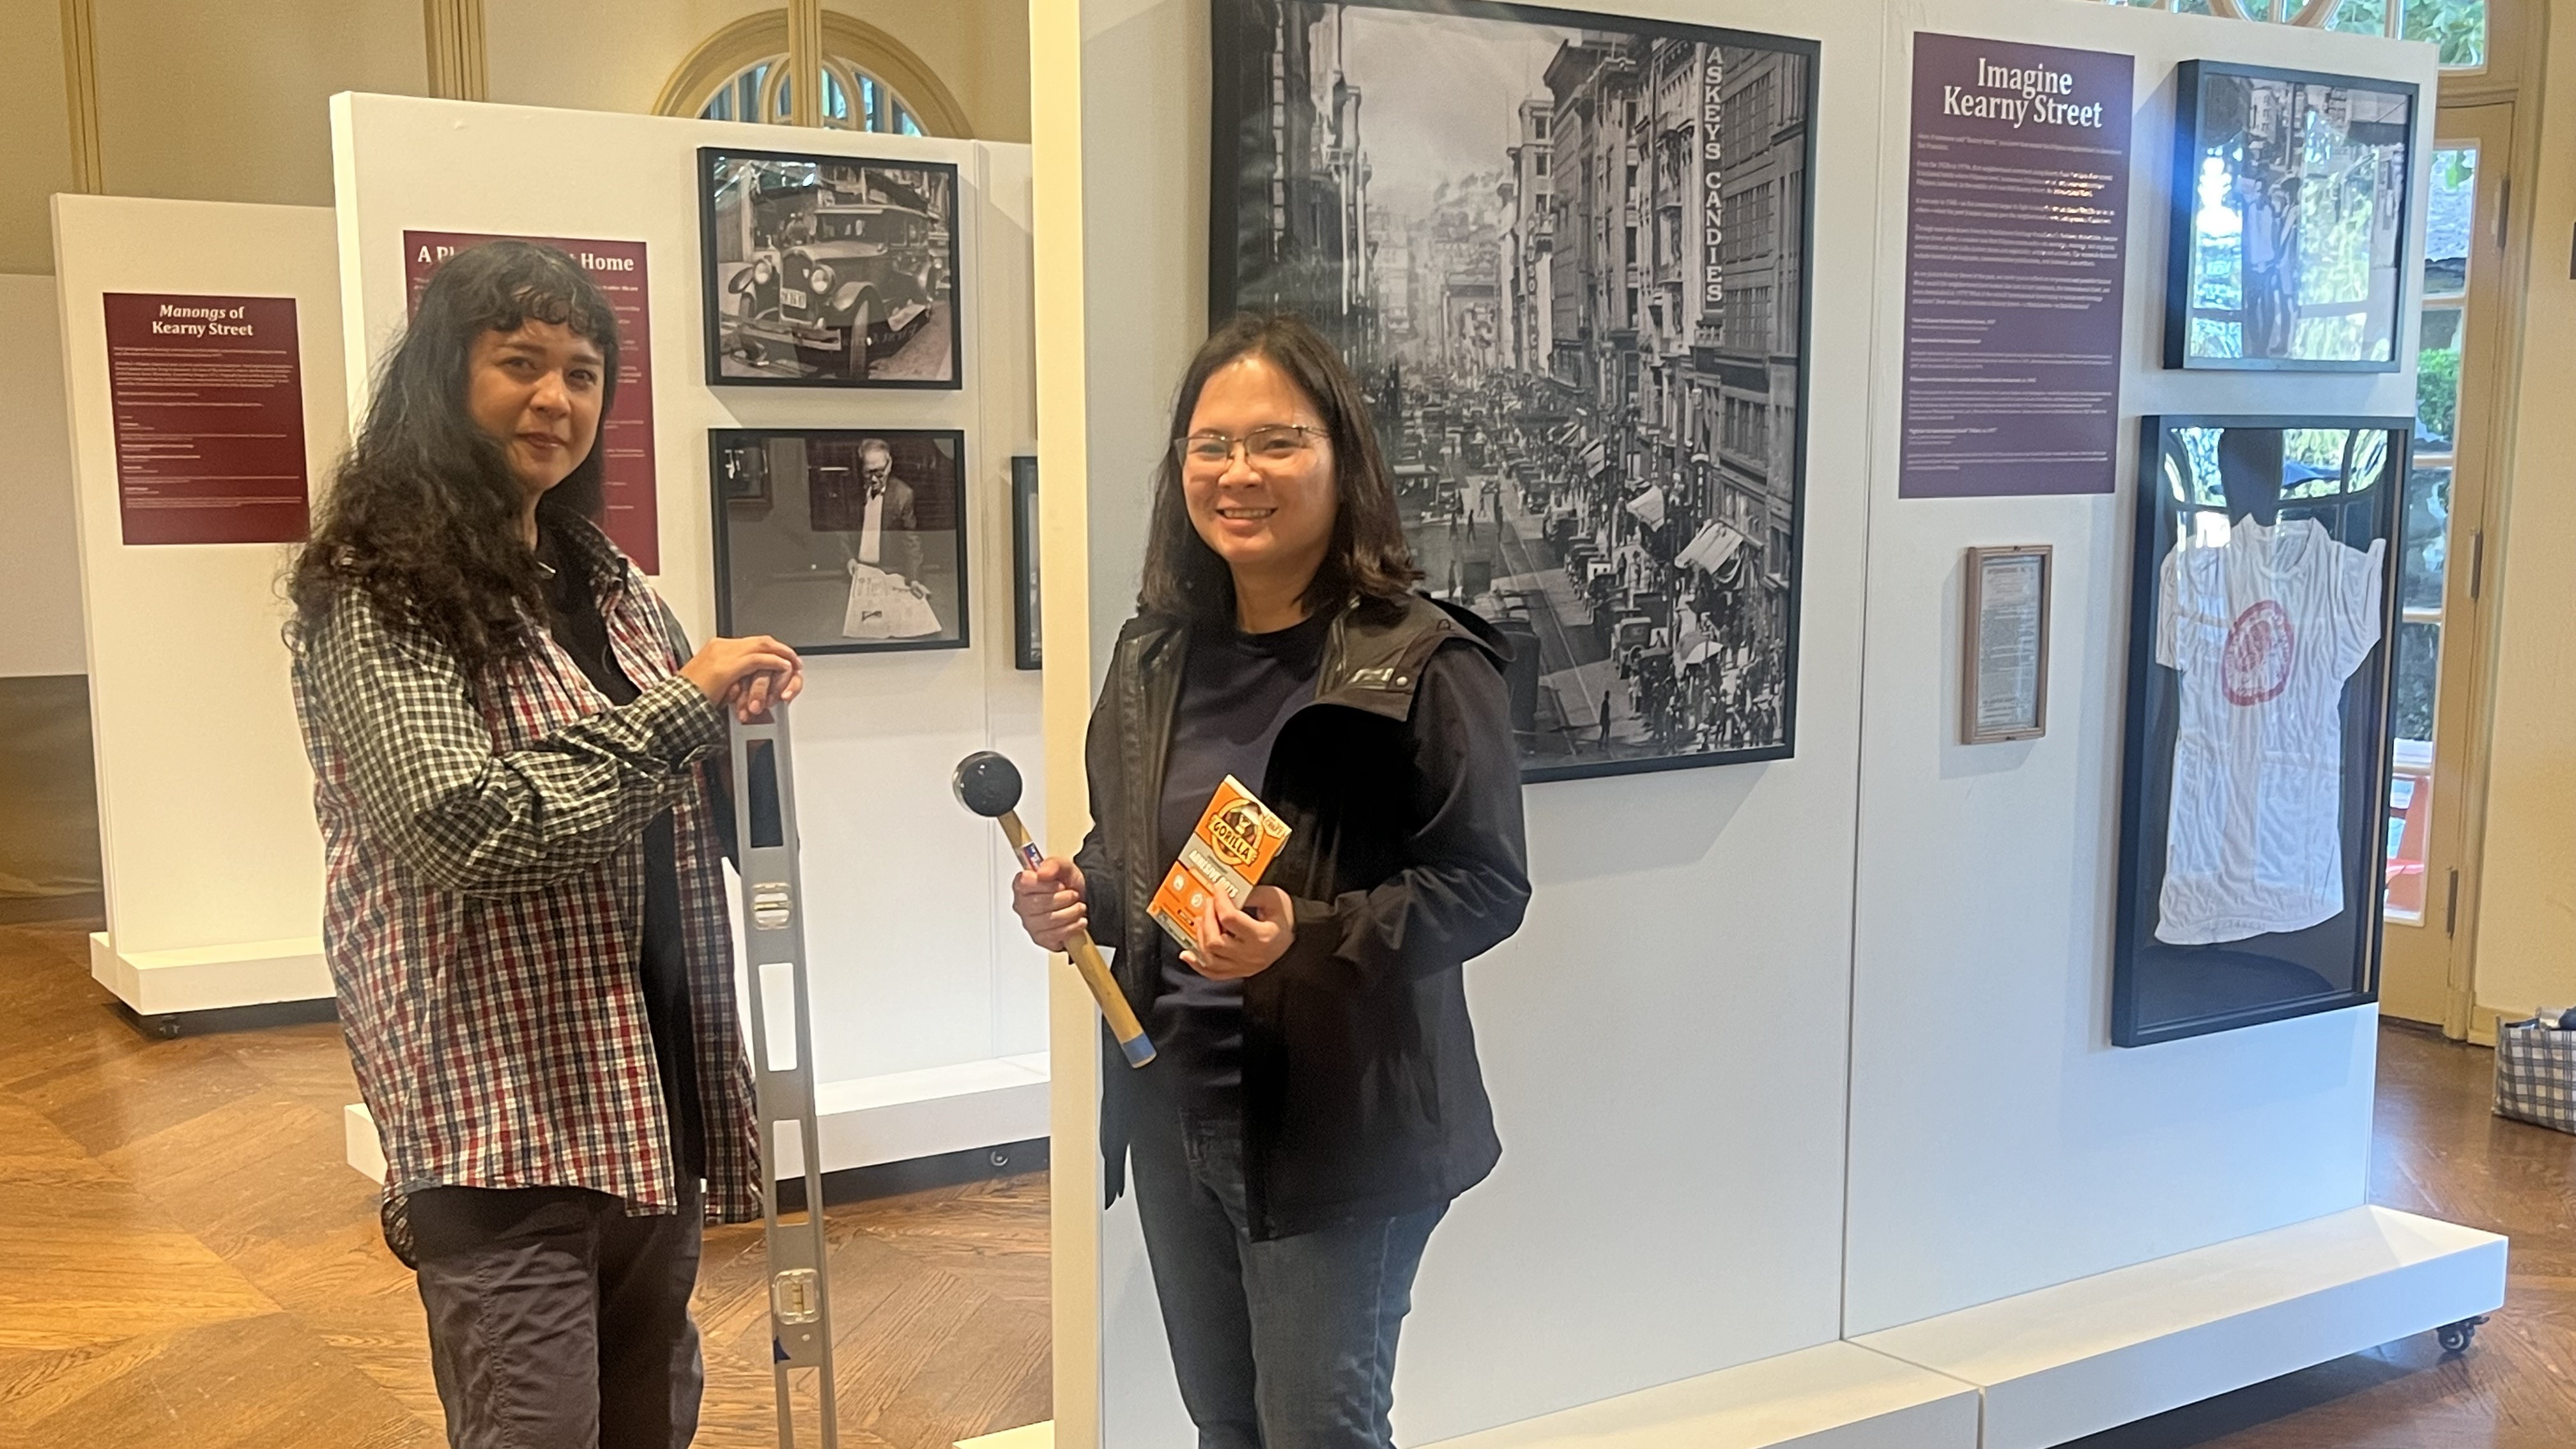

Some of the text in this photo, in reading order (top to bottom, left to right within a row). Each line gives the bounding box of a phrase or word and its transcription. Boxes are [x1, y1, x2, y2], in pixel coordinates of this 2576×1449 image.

[1977, 57, 2073, 100] Imagine
[1943, 85, 2103, 128] Kearny Street
[1705, 45, 1724, 303] ASKEYS CANDIES
[417, 245, 433, 263] A
[581, 252, 634, 272] Home
[159, 304, 245, 321] Manongs of
[152, 321, 254, 338] Kearny Street
[1212, 820, 1251, 861] GORILLA
[1188, 850, 1222, 883] ADHESIVE
